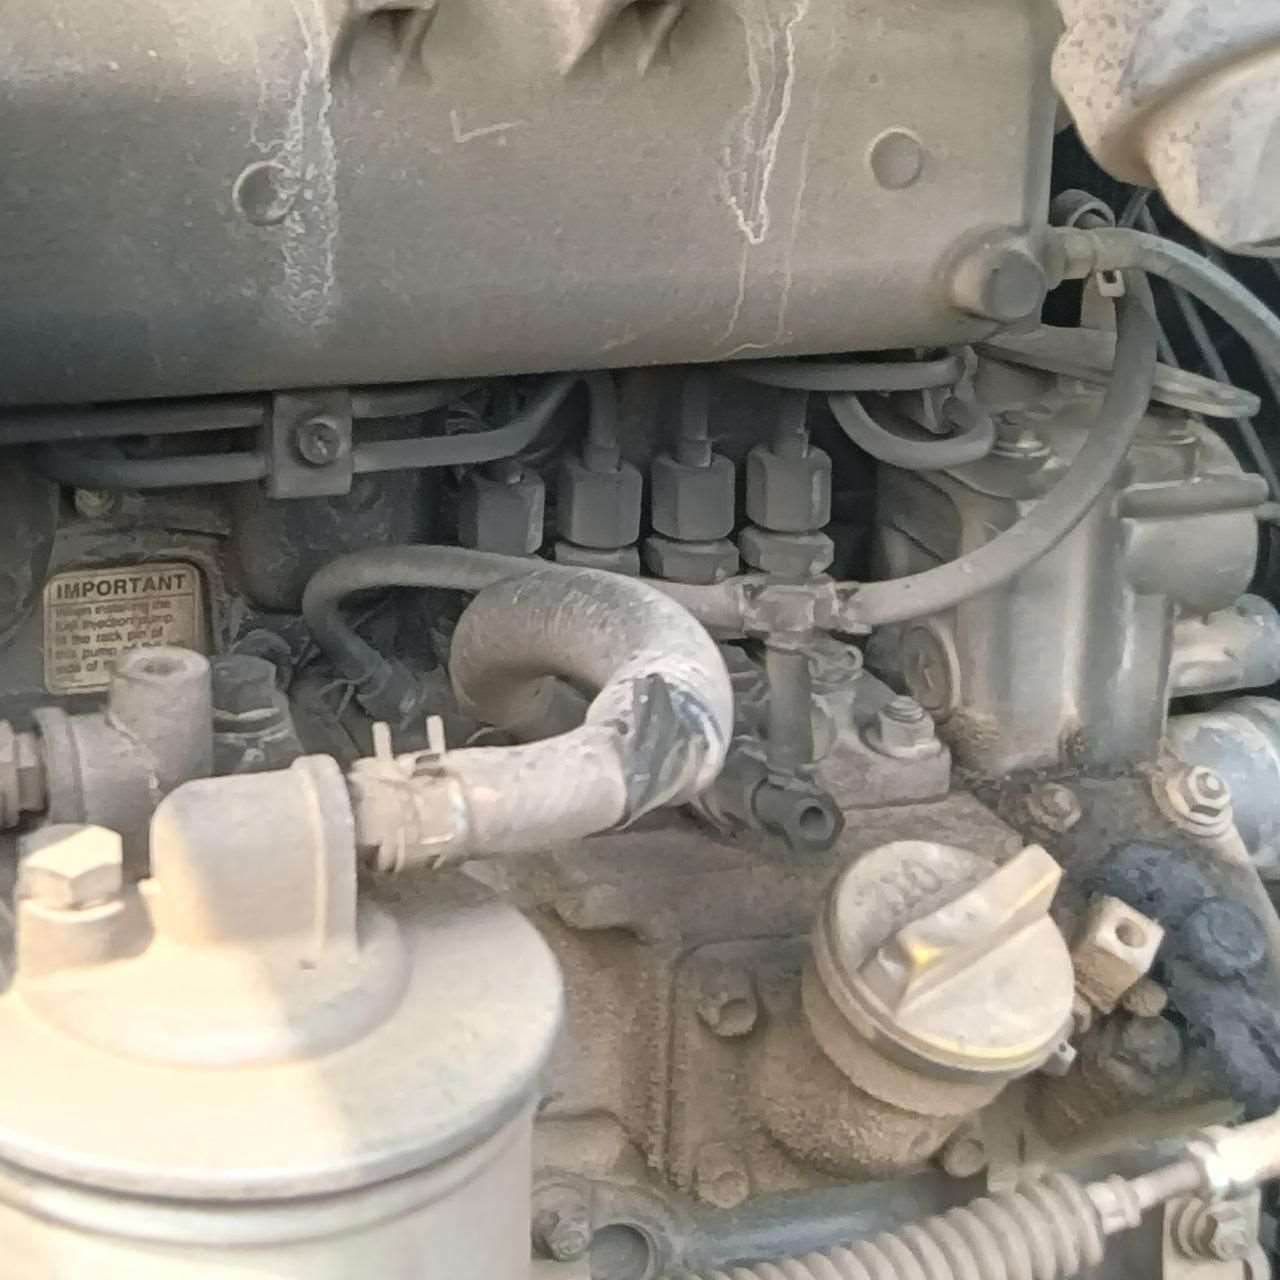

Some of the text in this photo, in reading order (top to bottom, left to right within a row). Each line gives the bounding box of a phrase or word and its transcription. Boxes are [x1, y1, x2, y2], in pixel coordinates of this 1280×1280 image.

[56, 574, 186, 599] IMPORTANT
[82, 616, 131, 631] injection
[71, 633, 90, 645] the
[96, 629, 122, 642] rack
[151, 626, 163, 638] of
[81, 647, 117, 660] pump
[86, 659, 98, 672] of
